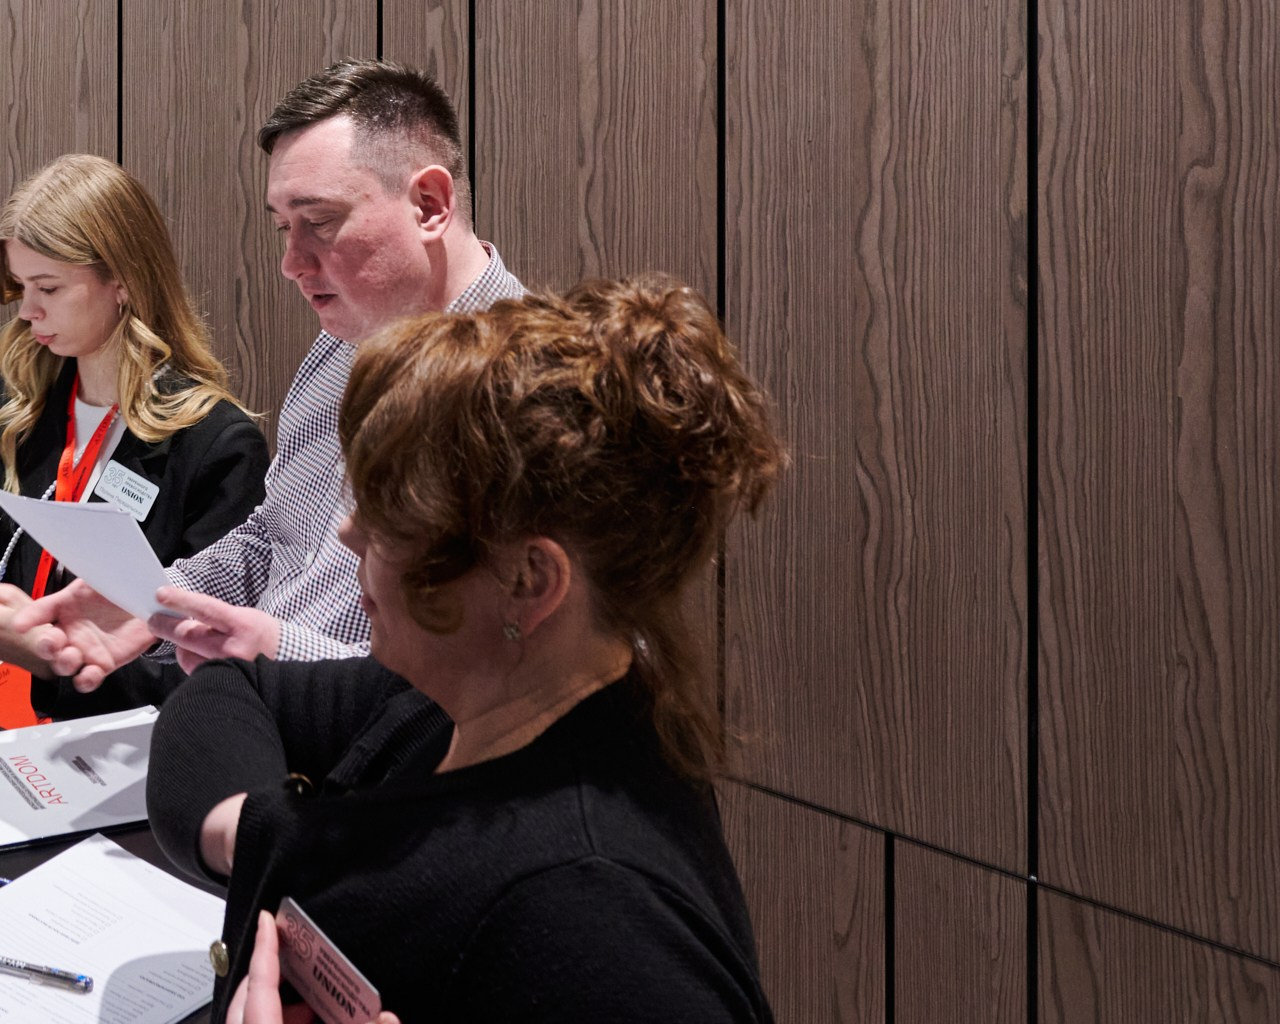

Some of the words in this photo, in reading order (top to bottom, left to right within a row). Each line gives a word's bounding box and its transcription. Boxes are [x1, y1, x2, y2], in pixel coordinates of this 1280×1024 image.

[121, 486, 145, 505] UNION
[8, 755, 69, 805] ARTDOM
[312, 964, 356, 1019] UNION
